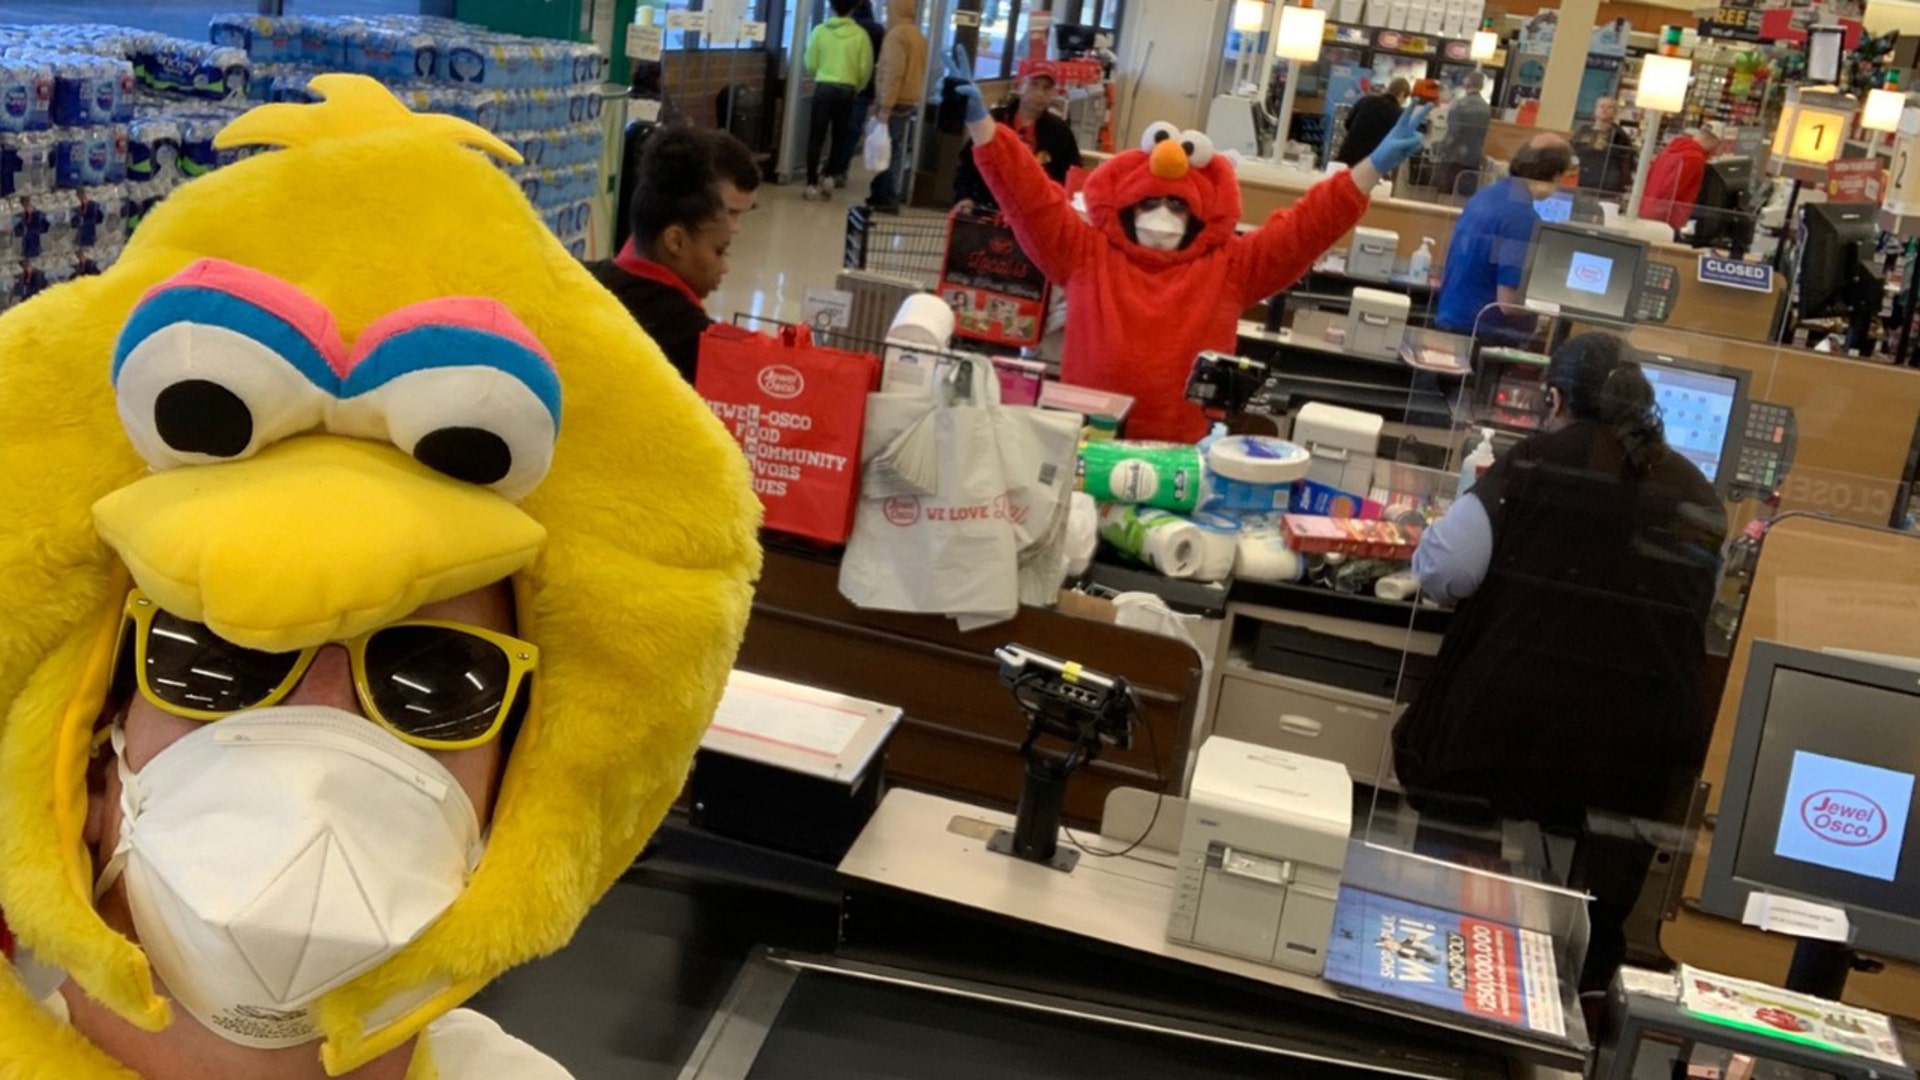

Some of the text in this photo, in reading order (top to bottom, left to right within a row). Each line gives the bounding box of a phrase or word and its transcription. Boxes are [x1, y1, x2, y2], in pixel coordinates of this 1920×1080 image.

[1711, 8, 1747, 26] REE
[1812, 124, 1825, 150] 1
[1895, 151, 1907, 189] 2
[1706, 259, 1765, 279] CLOSED
[746, 442, 847, 471] COMMUNITY
[753, 459, 800, 481] VORS
[754, 478, 788, 496] UES
[927, 507, 945, 520] WE
[949, 505, 988, 521] LOVE
[1813, 796, 1875, 822] Jewel
[1399, 918, 1437, 982] WN!
[1449, 932, 1466, 991] MONOPOLY
